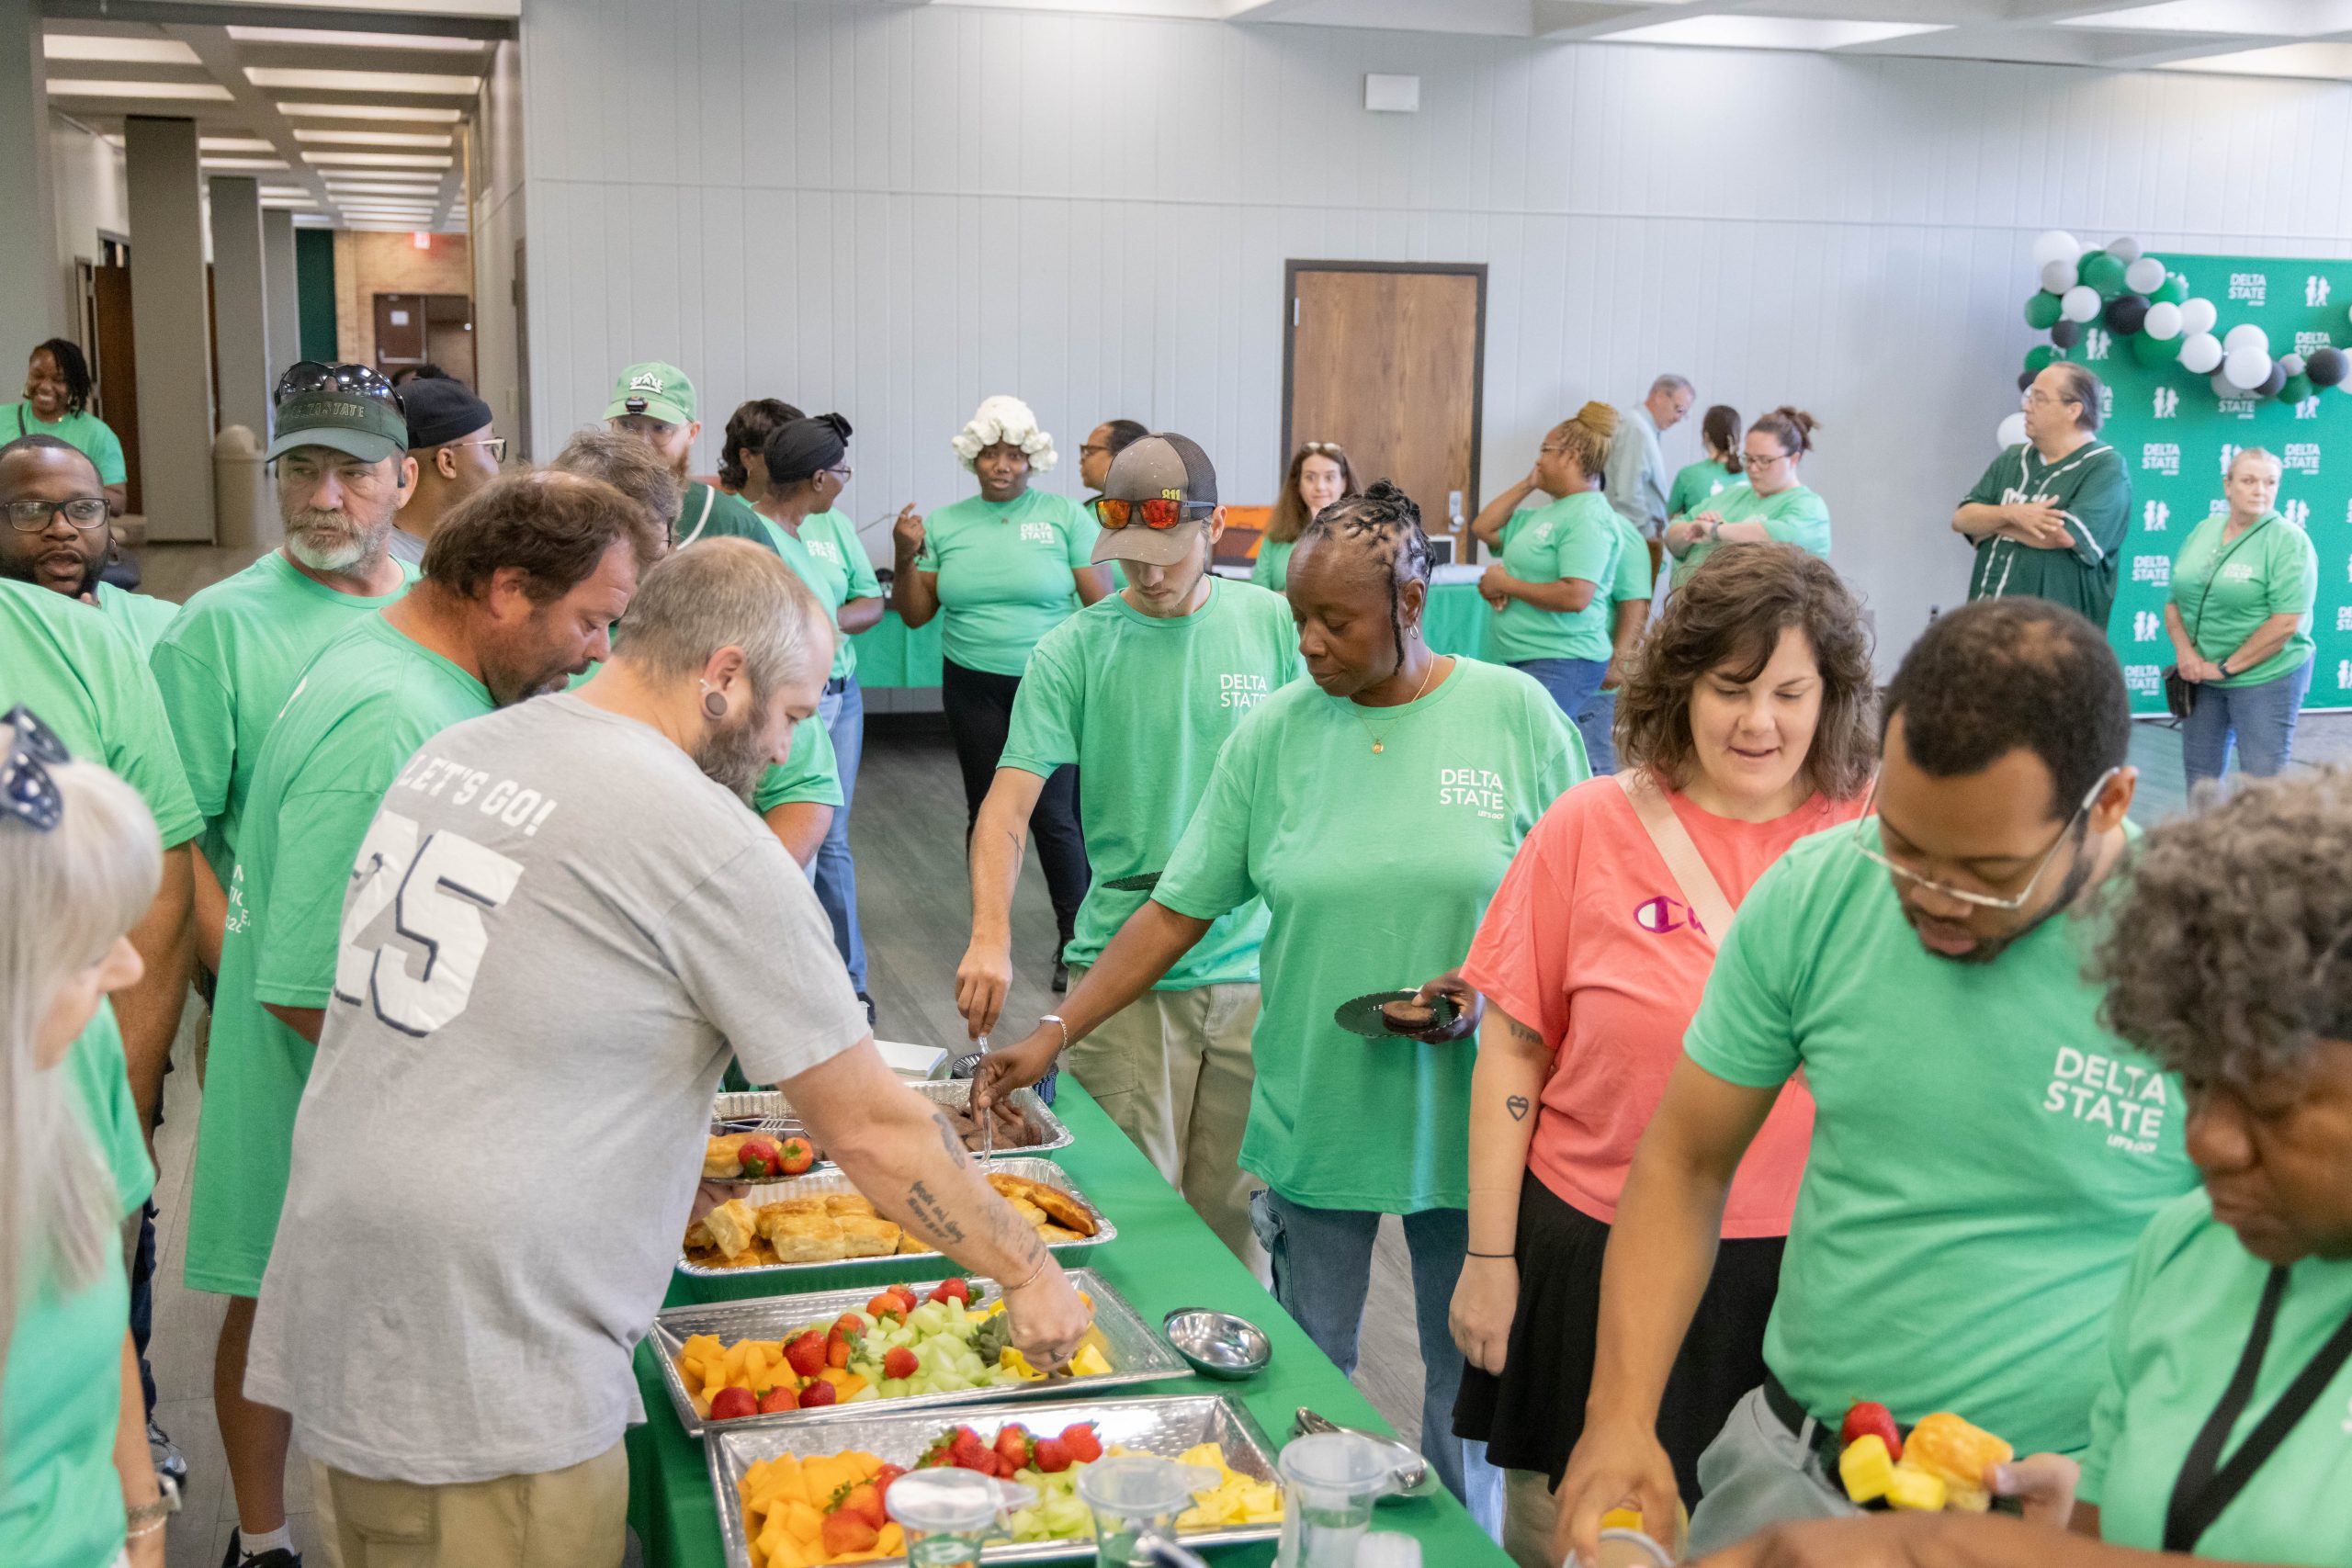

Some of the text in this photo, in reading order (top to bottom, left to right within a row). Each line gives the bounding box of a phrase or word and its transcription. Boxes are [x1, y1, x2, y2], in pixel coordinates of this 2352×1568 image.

[2230, 274, 2267, 286] DELTA
[2228, 287, 2266, 299] STATE
[2295, 332, 2331, 344] DELTA
[2219, 400, 2255, 412] STATE
[2143, 444, 2180, 456] DELTA
[2285, 444, 2321, 456] DELTA
[2142, 457, 2179, 468] STATE
[2282, 456, 2320, 468] STATE
[1021, 523, 1052, 532] DELTA
[1020, 532, 1054, 541] STATE
[2133, 556, 2170, 568] DELTA
[2132, 569, 2169, 581] STATE
[2124, 665, 2160, 676] DELTA
[1219, 673, 1267, 691] DELTA
[1441, 769, 1503, 790] DELTA
[397, 754, 558, 837] LET'S GO!
[1440, 787, 1504, 810] STATE
[334, 808, 526, 1039] 25
[2053, 1045, 2166, 1106] DELTA
[2042, 1079, 2165, 1138] STATE
